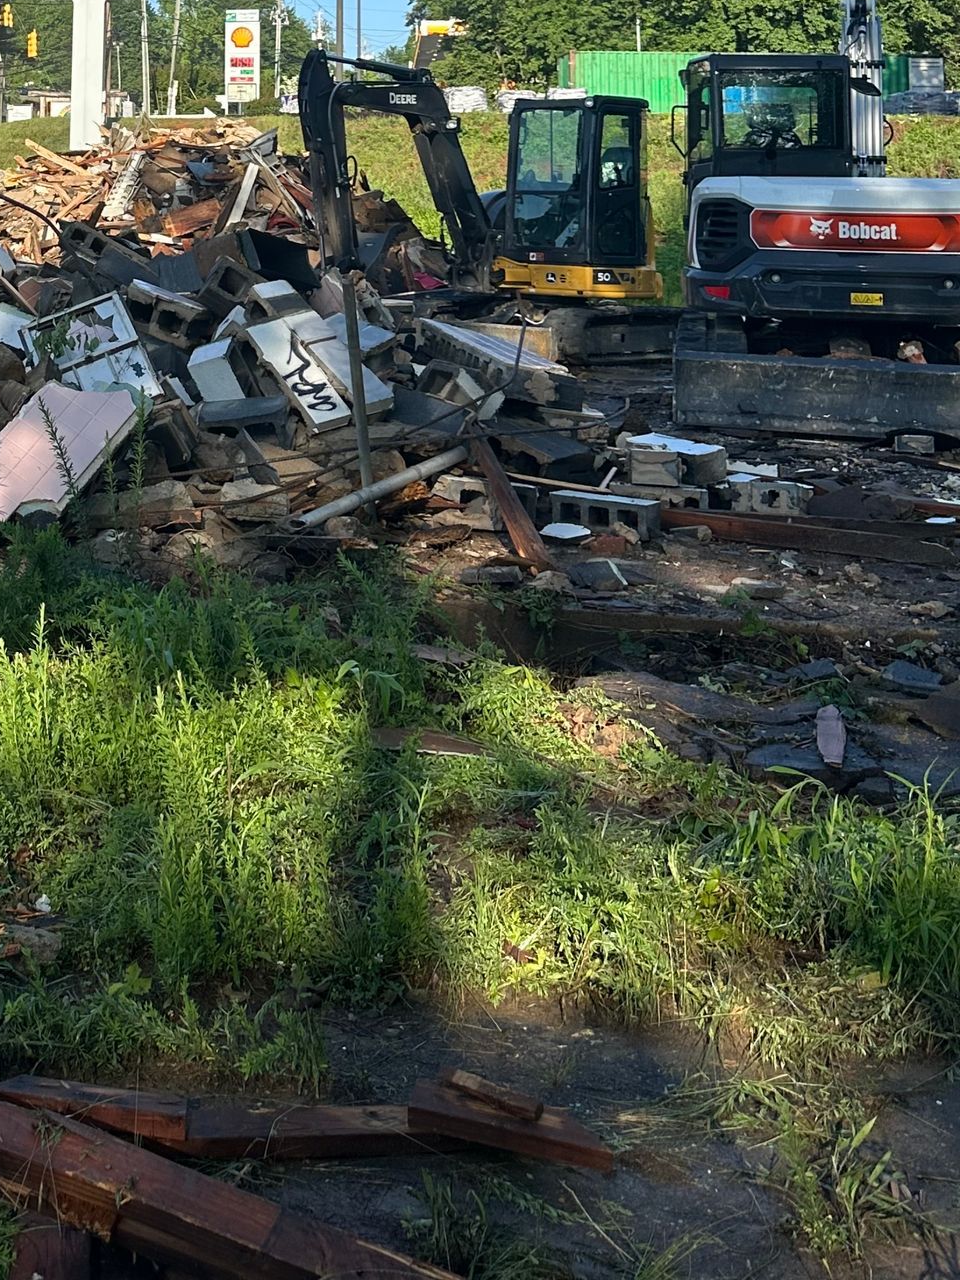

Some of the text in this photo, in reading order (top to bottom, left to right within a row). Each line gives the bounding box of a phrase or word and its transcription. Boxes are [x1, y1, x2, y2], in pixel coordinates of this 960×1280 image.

[389, 92, 417, 105] DEERE
[838, 221, 898, 240] Bobcat
[597, 272, 611, 282] 50
